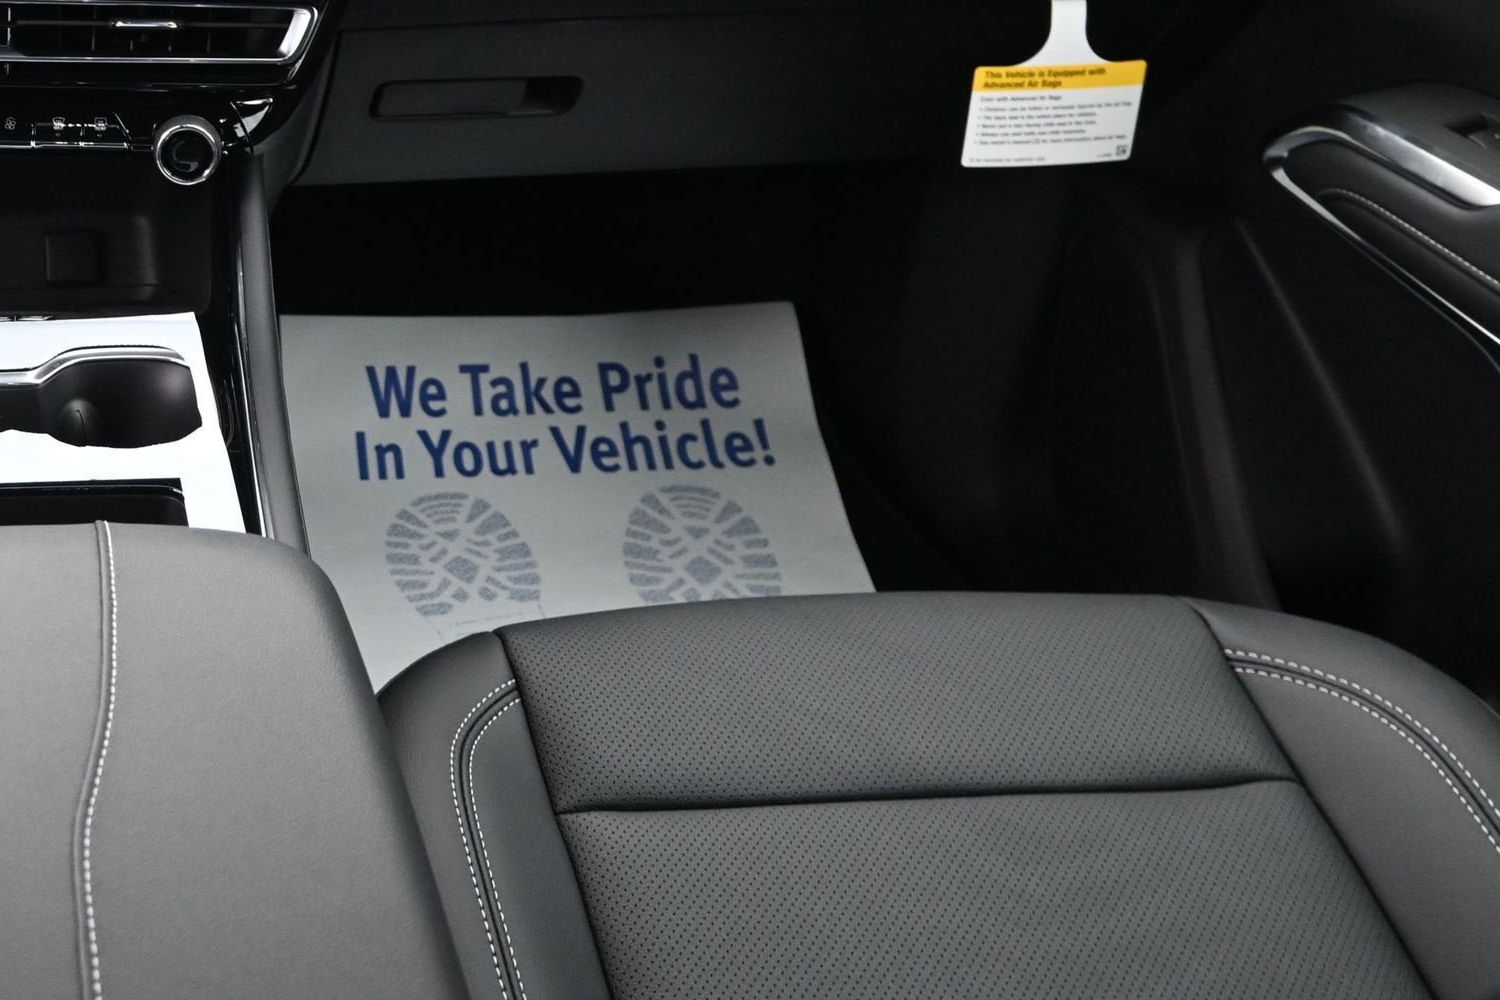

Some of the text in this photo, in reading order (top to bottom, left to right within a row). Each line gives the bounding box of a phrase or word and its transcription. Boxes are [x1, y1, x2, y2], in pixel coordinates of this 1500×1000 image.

[983, 80, 1062, 89] Advanced Air Bags
[985, 67, 1106, 79] This Vehicle is Equipped with
[366, 353, 741, 418] We Take Pride
[355, 418, 776, 480] In Your Vehicle!
